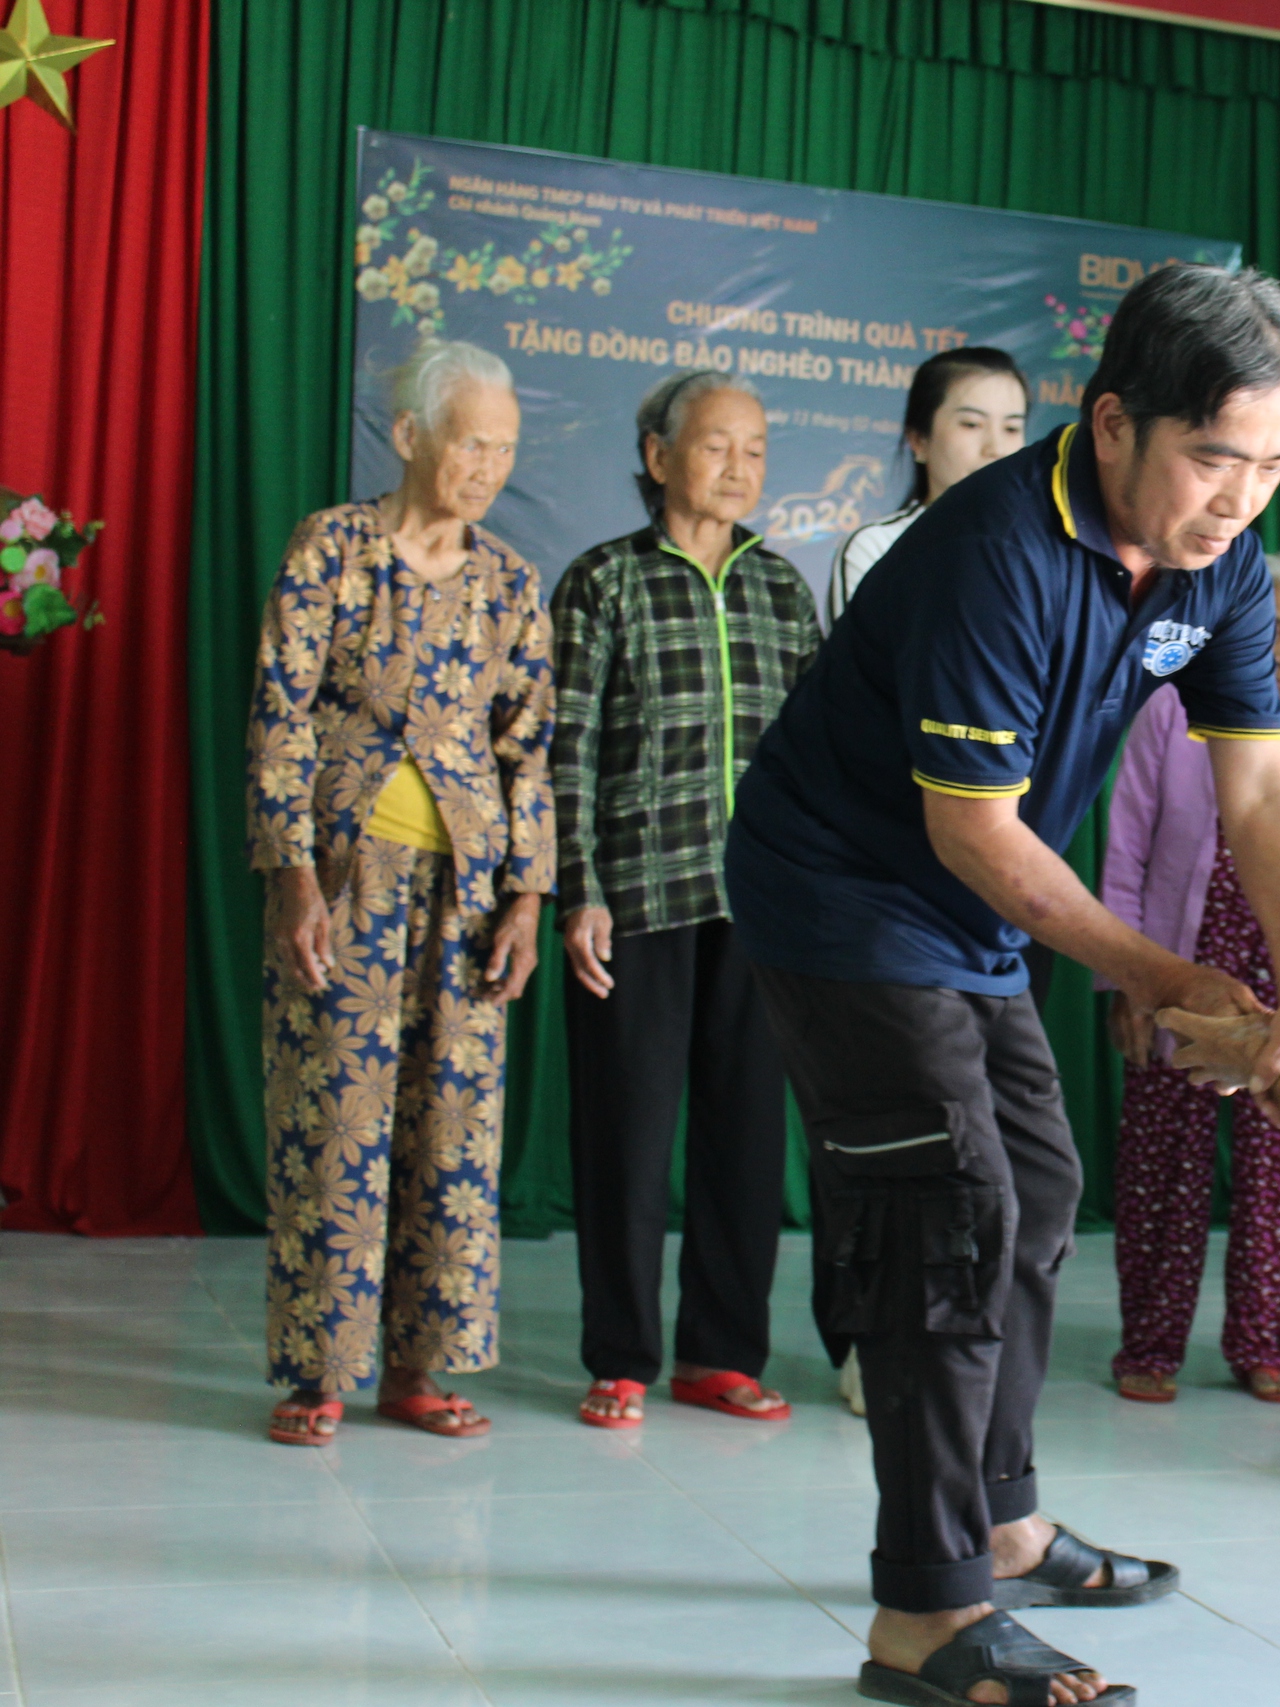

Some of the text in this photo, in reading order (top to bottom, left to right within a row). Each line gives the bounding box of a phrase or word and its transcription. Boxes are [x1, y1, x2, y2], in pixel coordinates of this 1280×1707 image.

[667, 300, 968, 351] CHƯƠNG TRÌNH QUÀ TẾT
[504, 318, 583, 357] TẶNG
[588, 326, 669, 366] ĐỒNG
[674, 336, 733, 373] BÀO
[738, 347, 833, 382] NGHÈO
[837, 356, 917, 389] THÀN
[767, 499, 861, 539] 2026
[920, 718, 1017, 745] QUALITY SERVICE
